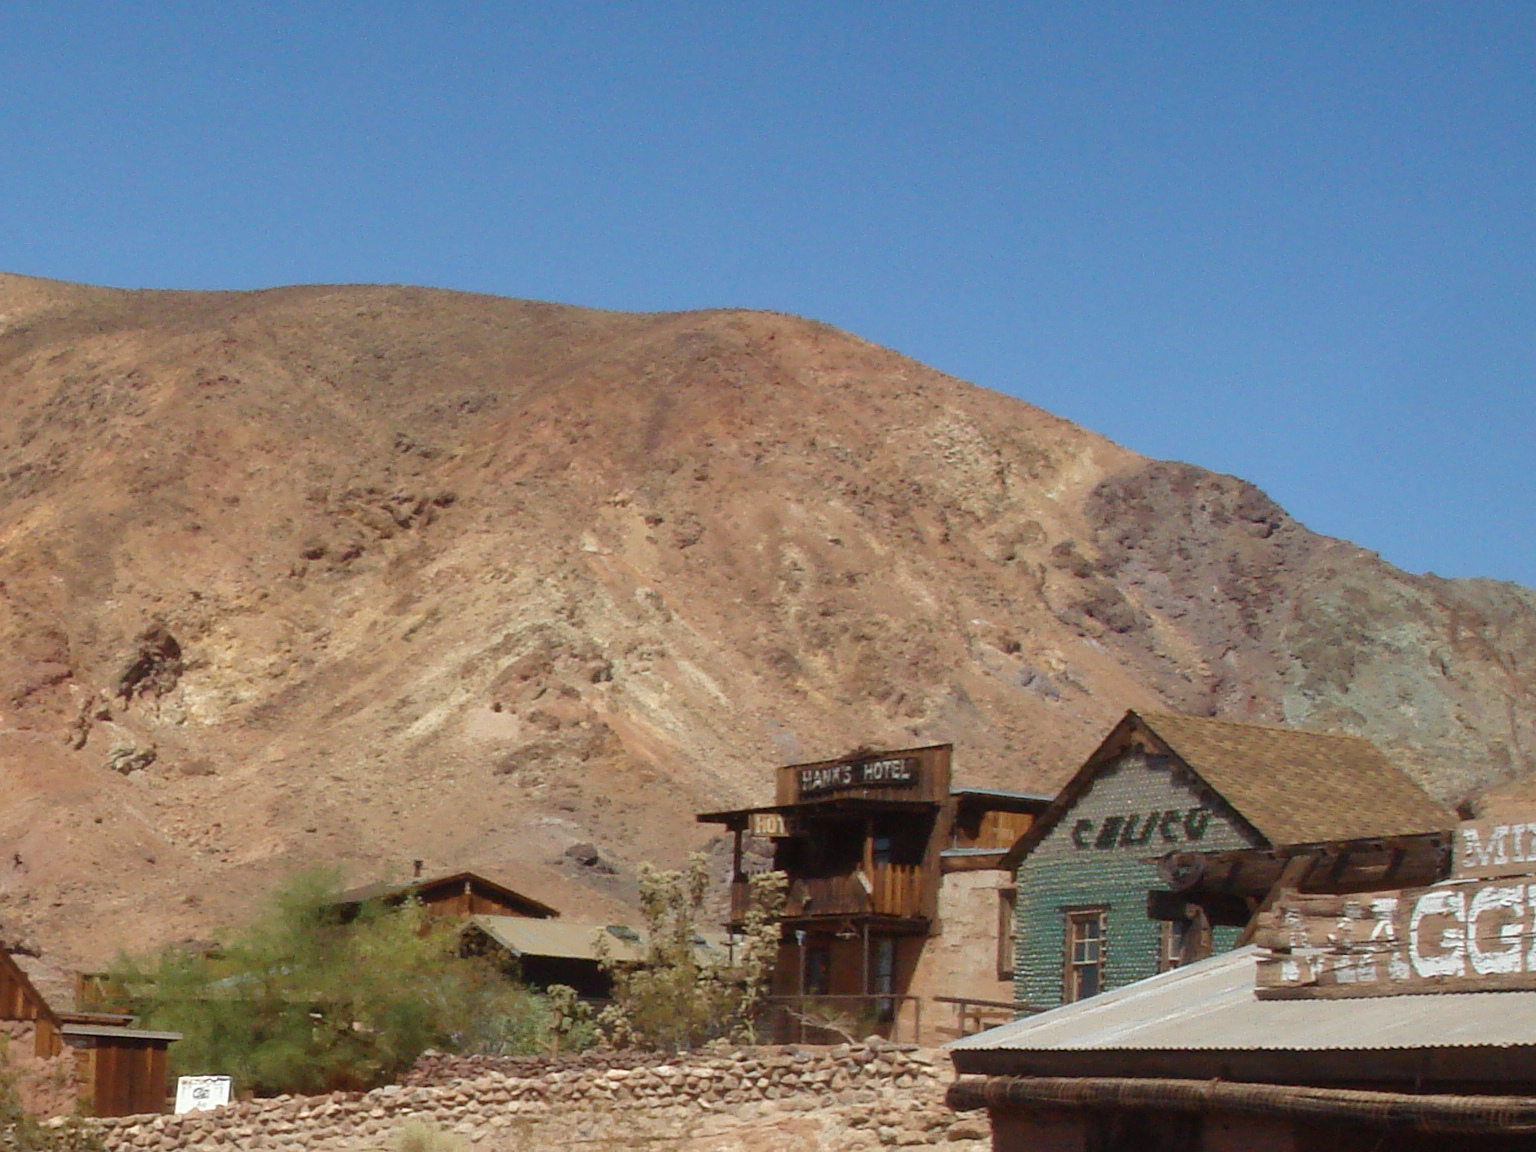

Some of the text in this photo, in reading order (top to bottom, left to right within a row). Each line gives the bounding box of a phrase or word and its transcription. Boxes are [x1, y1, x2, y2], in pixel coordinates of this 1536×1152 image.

[802, 758, 911, 791] HANK'S HOTEL
[1072, 807, 1212, 849] CALICO
